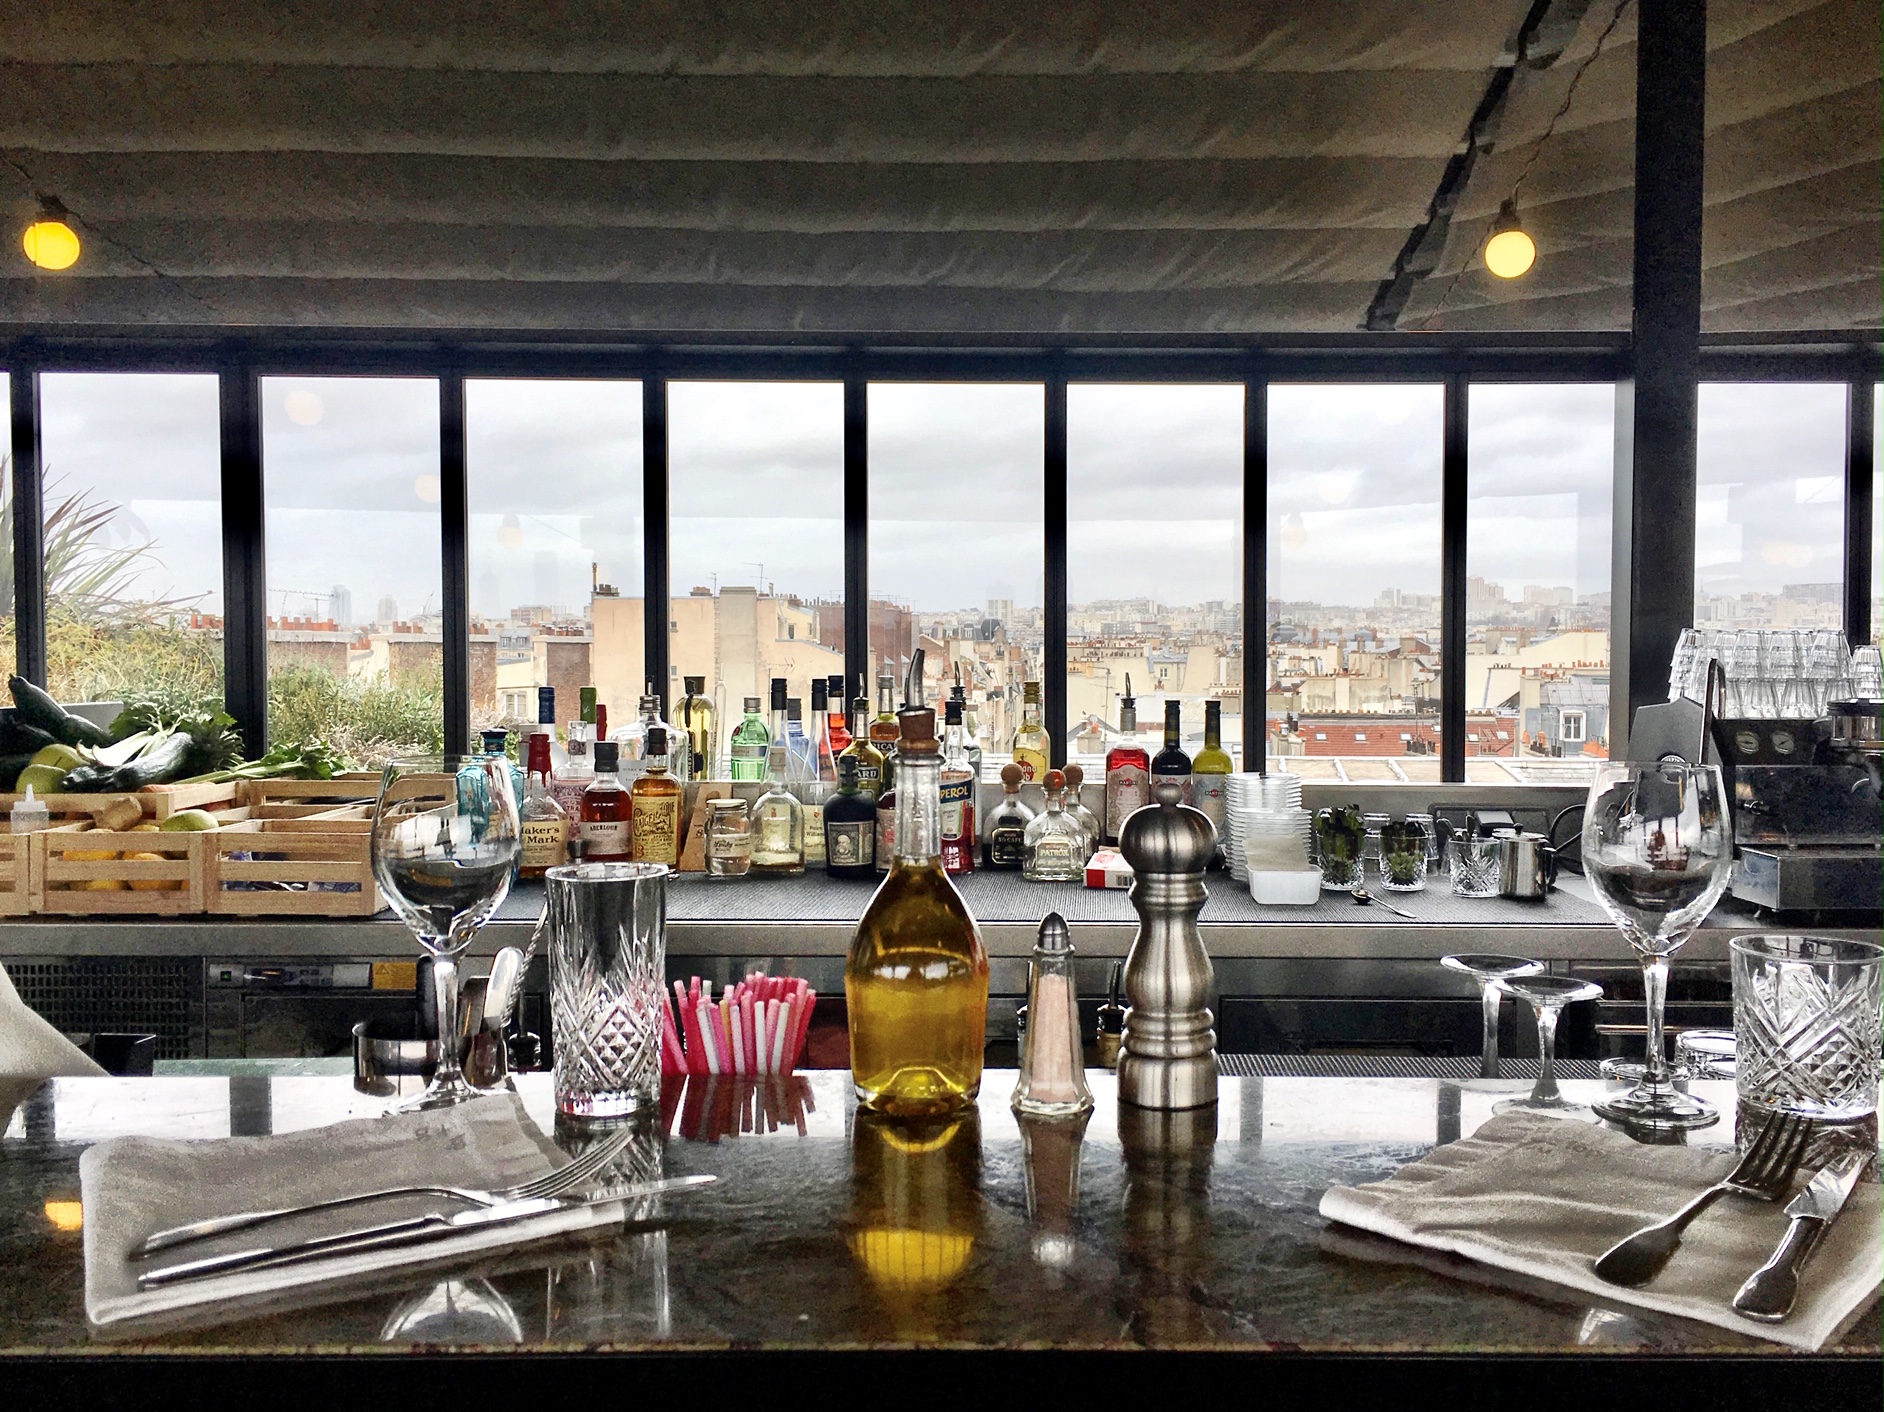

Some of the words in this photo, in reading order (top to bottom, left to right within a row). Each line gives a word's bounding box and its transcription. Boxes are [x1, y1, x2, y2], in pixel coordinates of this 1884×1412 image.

[857, 770, 877, 778] ARD
[940, 786, 968, 799] PEROL
[527, 835, 559, 844] Mark
